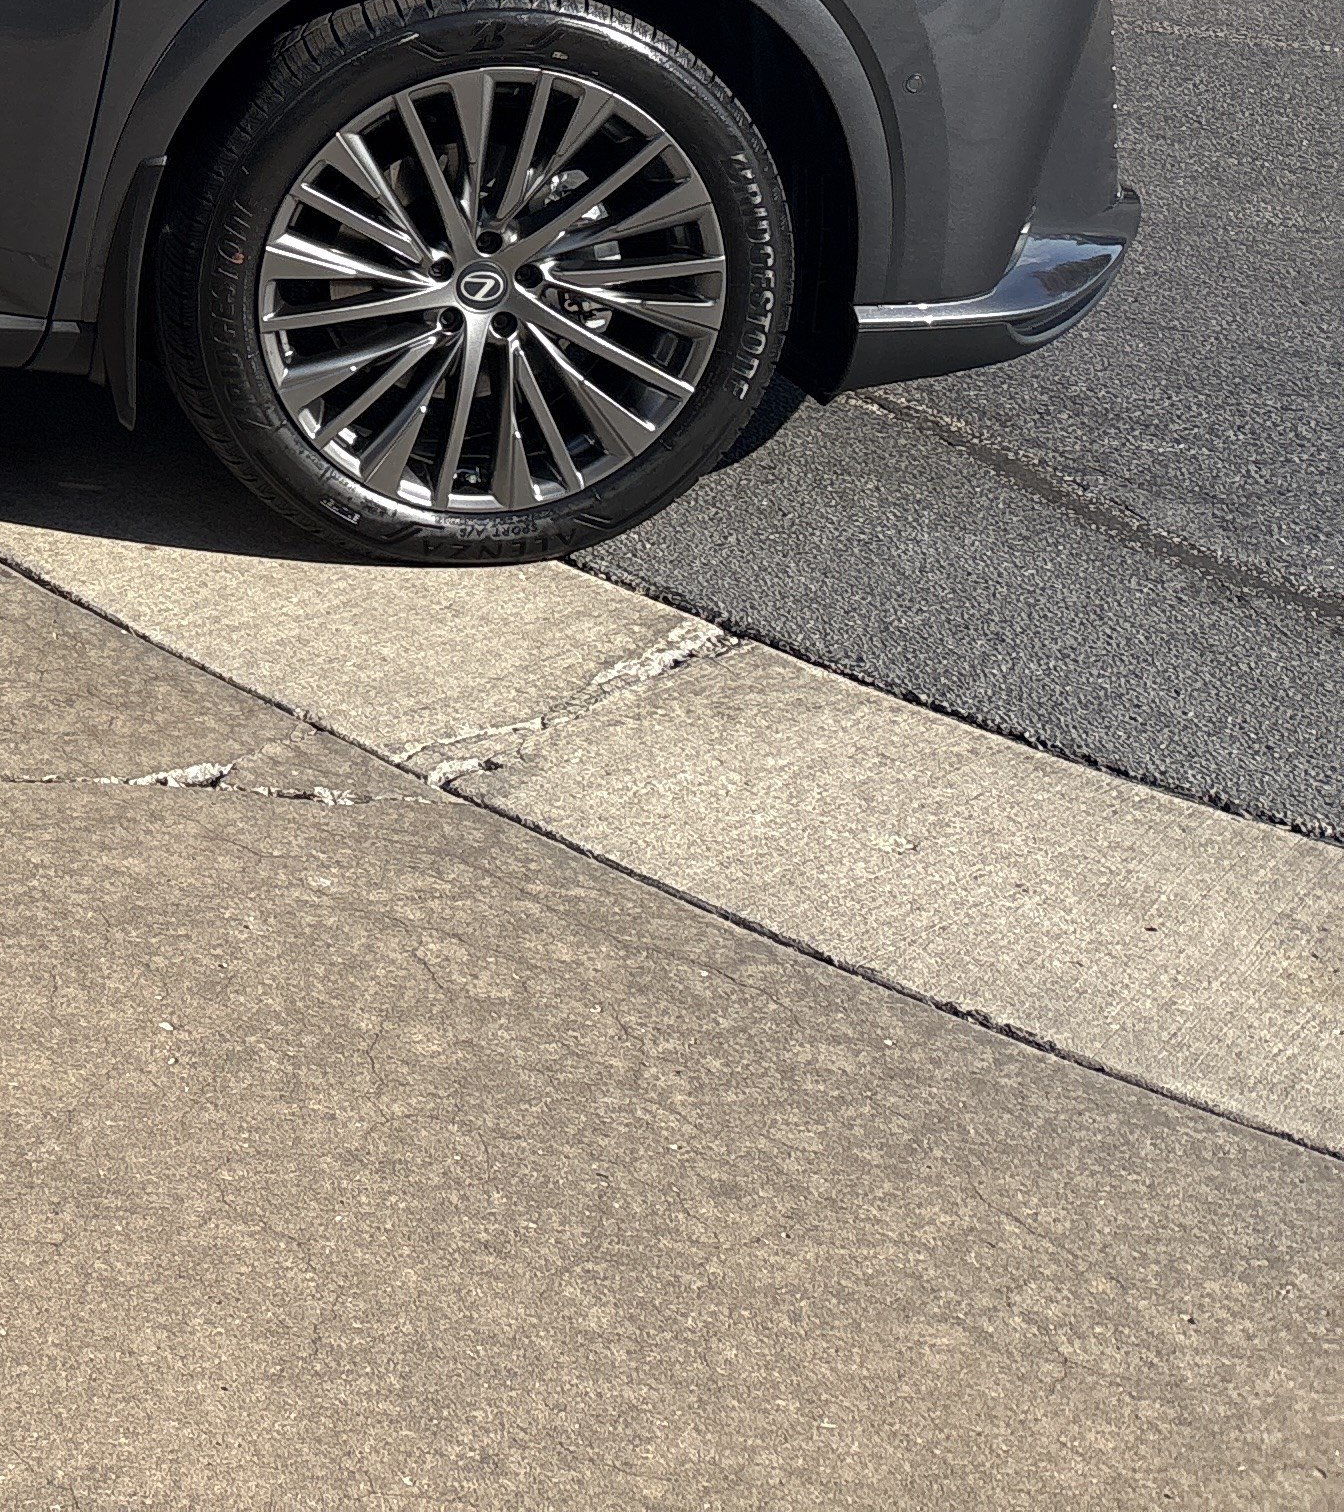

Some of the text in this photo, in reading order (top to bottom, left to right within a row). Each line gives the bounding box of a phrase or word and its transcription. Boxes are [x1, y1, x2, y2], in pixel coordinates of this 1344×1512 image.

[719, 153, 775, 400] BRIDGESTONE
[422, 528, 578, 557] ALENZA
[492, 524, 538, 538] SPORT
